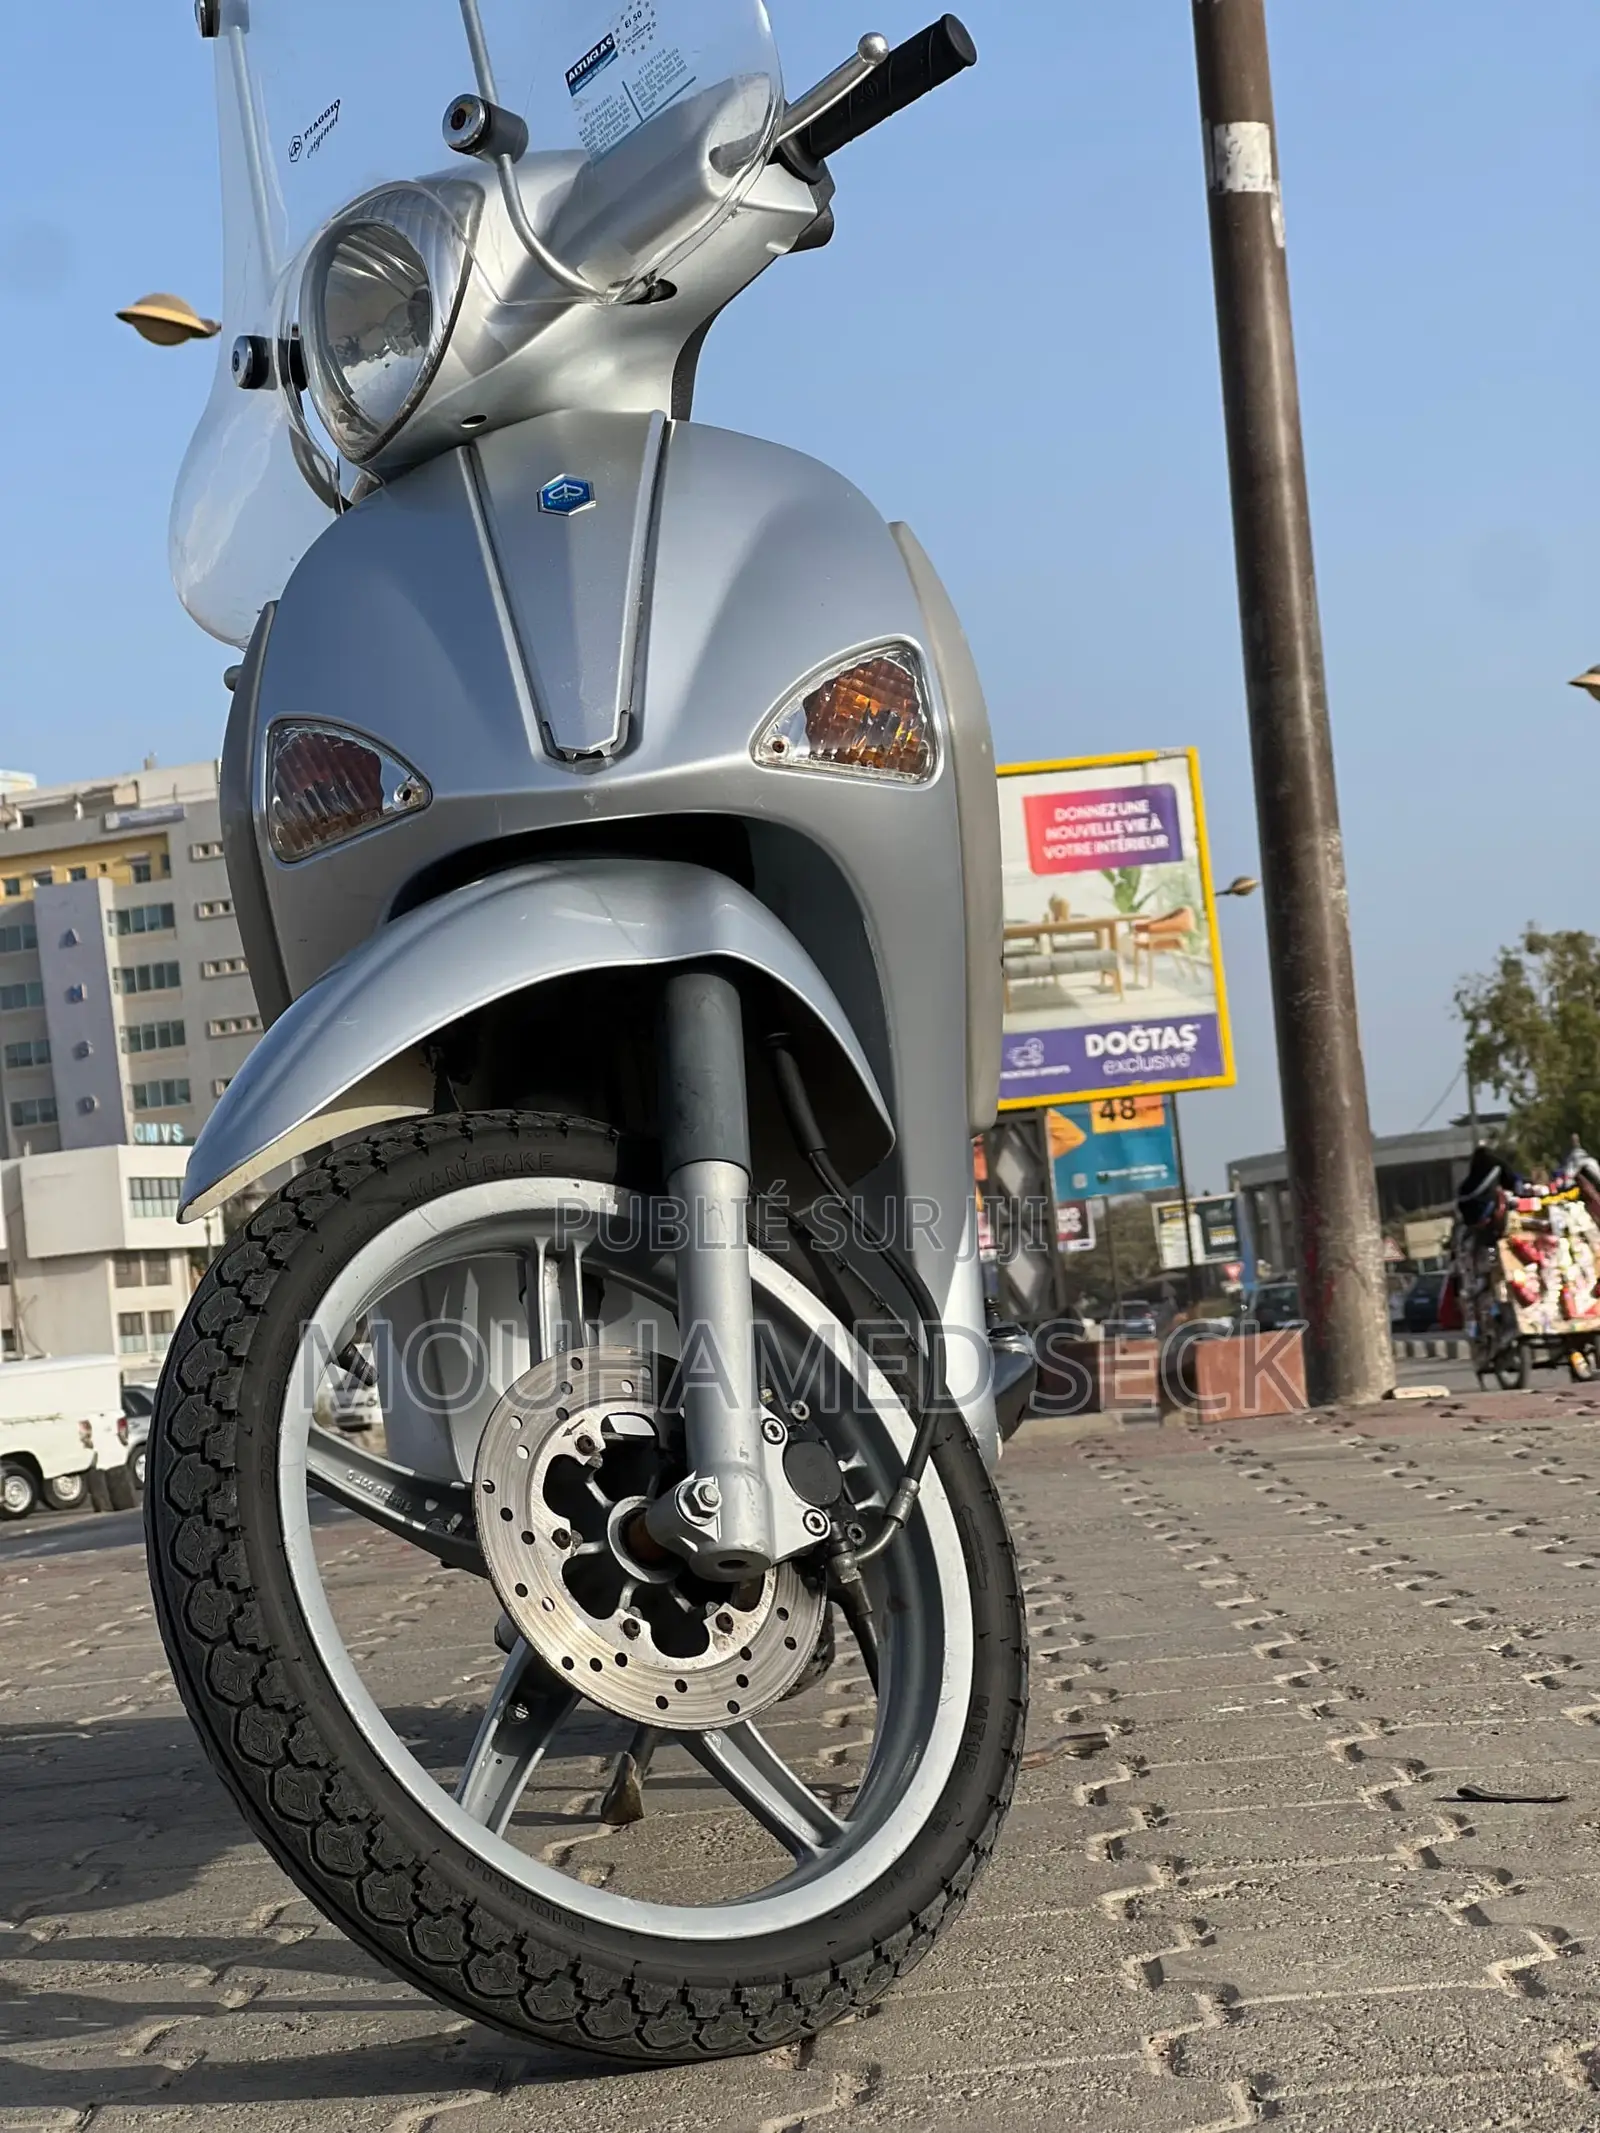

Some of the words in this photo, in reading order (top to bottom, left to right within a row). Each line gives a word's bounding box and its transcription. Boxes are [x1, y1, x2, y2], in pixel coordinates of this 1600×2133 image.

[632, 10, 642, 22] 50
[567, 35, 613, 82] ALTUGLAS
[304, 98, 341, 141] PIAGGIO
[1054, 802, 1117, 822] DONNEZ
[1117, 799, 1150, 816] UNE
[1045, 820, 1125, 841] NOUVELLE
[1124, 817, 1149, 834] VIE
[1042, 842, 1093, 860] VOTRE
[1093, 834, 1170, 856] INTÉRIEUR
[1102, 1052, 1191, 1076] exclusive
[1100, 1097, 1136, 1121] 48
[409, 1151, 554, 1200] MANDRAKE
